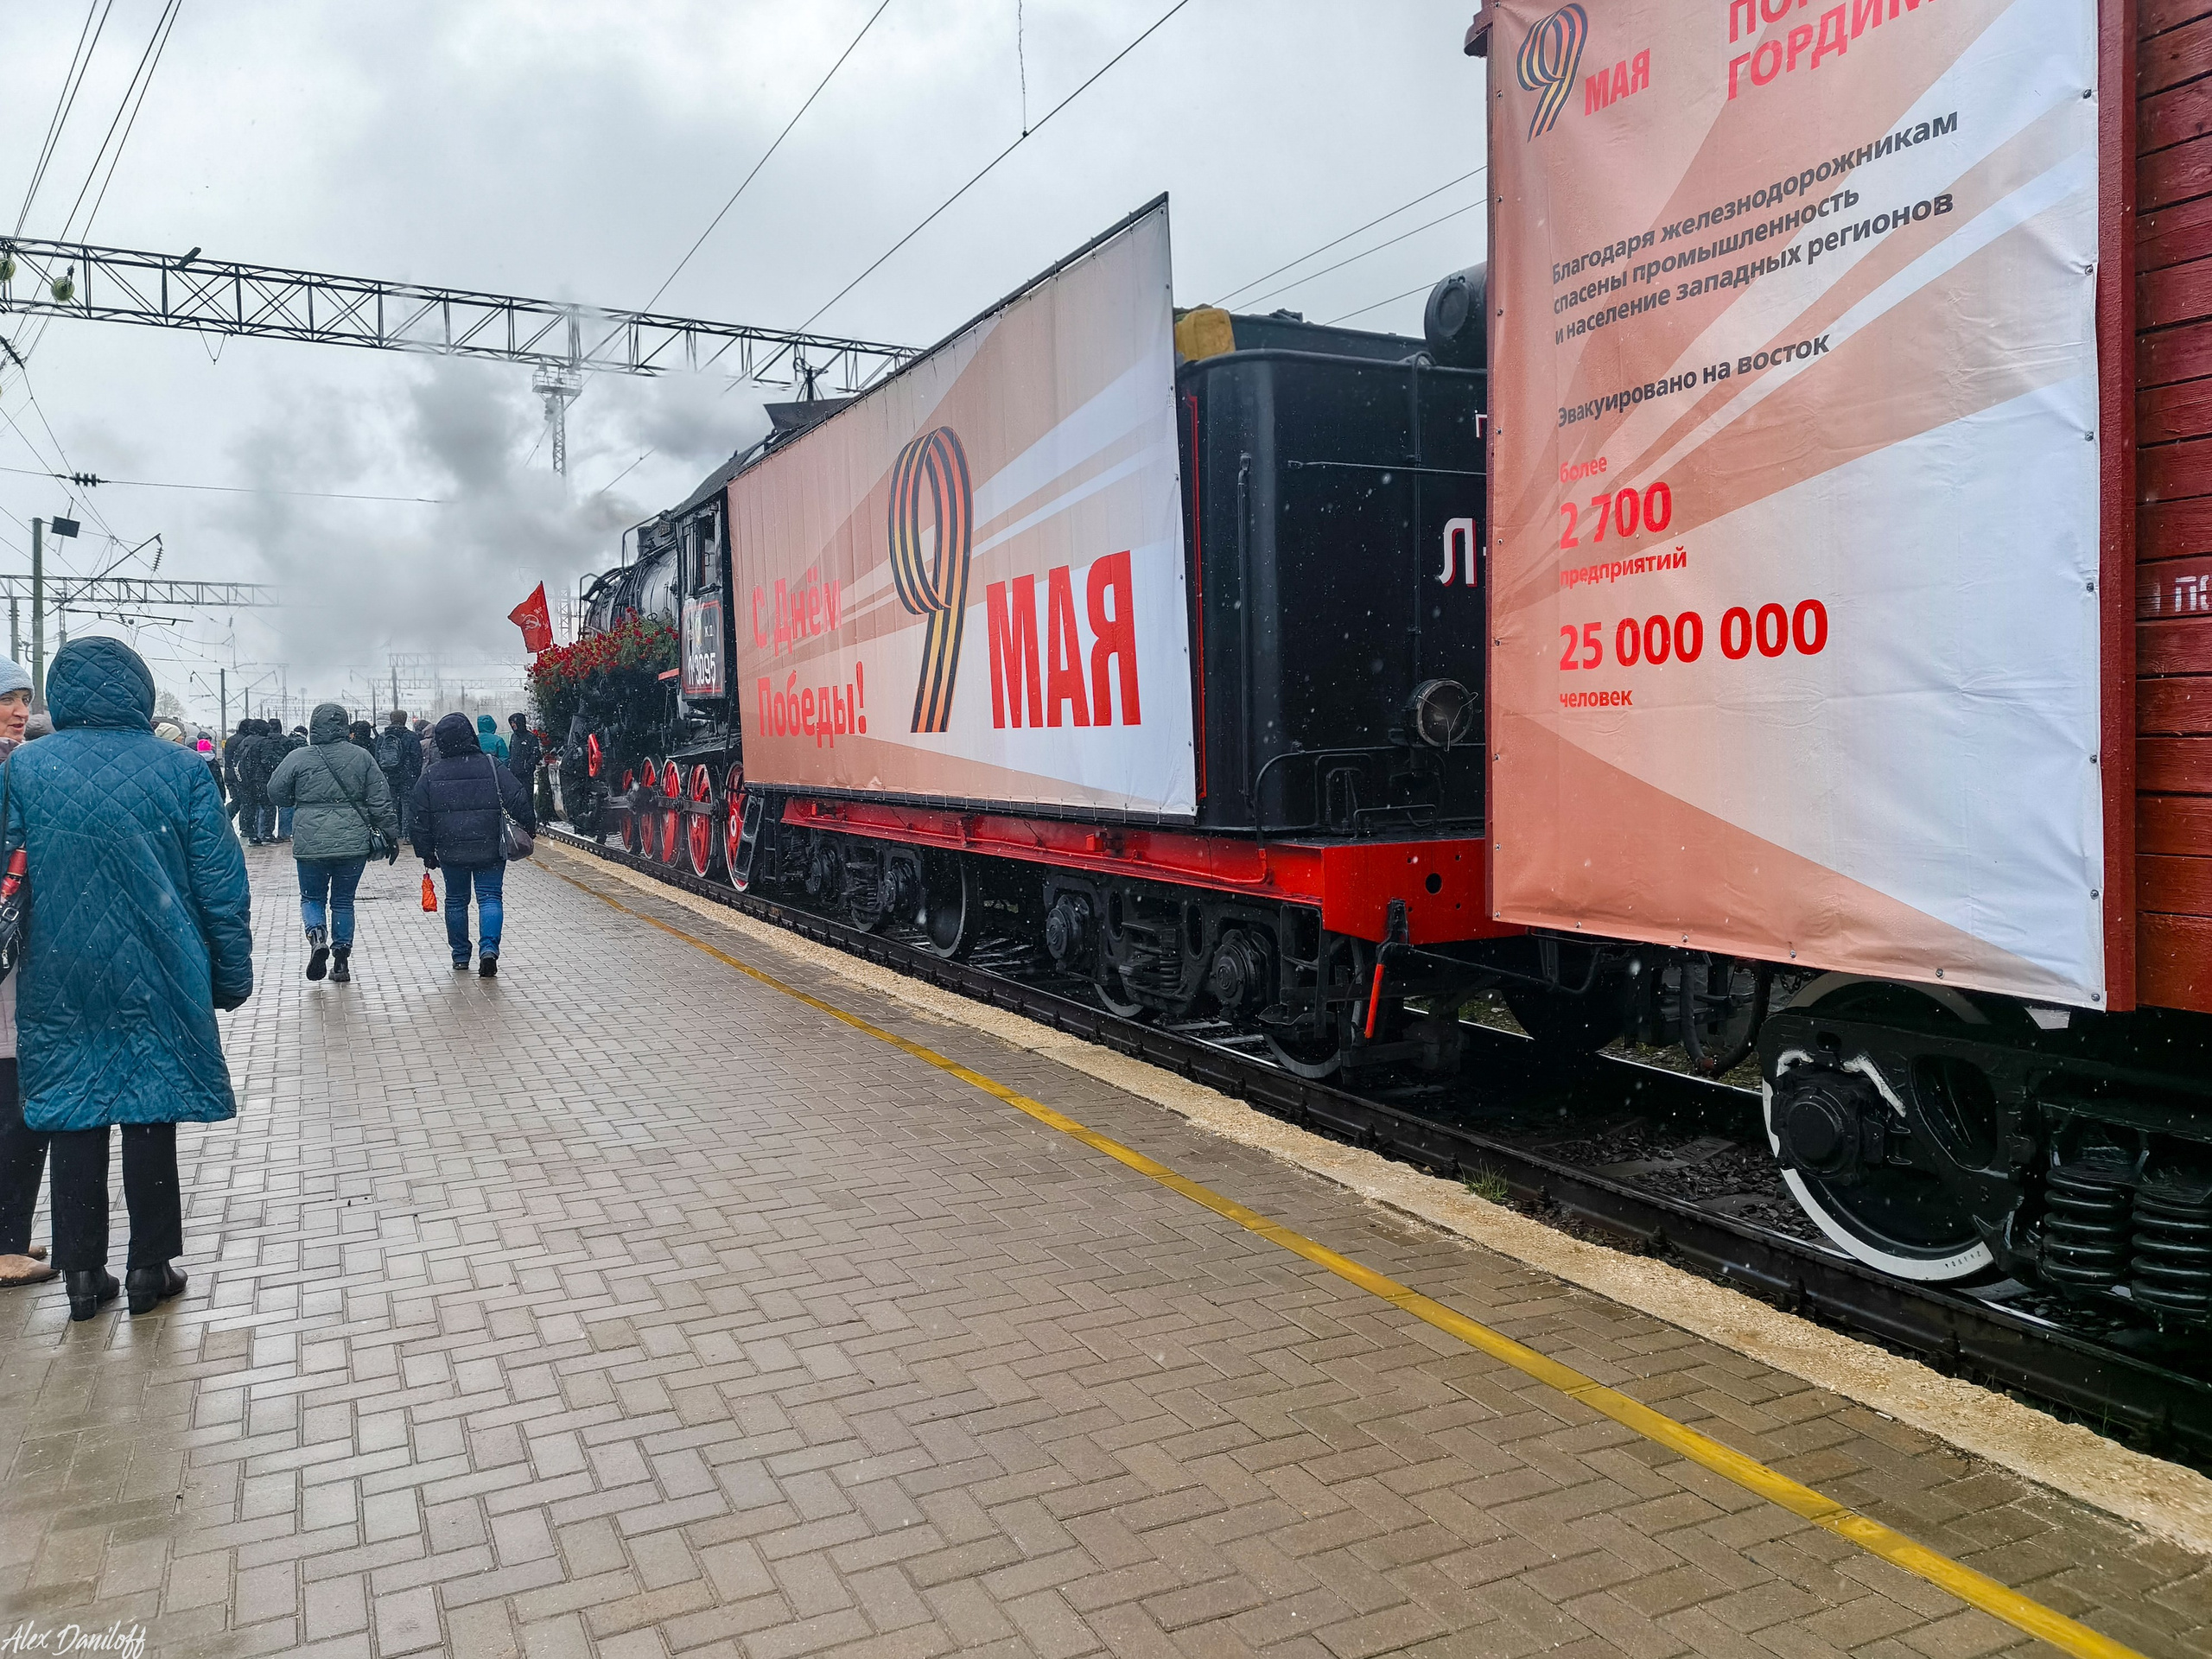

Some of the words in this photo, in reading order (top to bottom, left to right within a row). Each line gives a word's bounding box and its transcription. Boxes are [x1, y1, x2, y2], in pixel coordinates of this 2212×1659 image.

[1585, 48, 1650, 117] МАЯ
[1552, 230, 1656, 285] Благодаря
[1660, 111, 1958, 244] железнодорожникам
[1554, 270, 1628, 315] спасены
[1632, 188, 1860, 284] промышленность
[1554, 329, 1565, 346] и
[1567, 288, 1671, 340] население
[1675, 244, 1802, 302] западных
[1807, 193, 1955, 265] регионов
[1558, 371, 1697, 428] Эвакуировано
[1702, 360, 1732, 385] на
[1737, 334, 1831, 375] восток
[1559, 456, 1608, 484] более
[1591, 481, 1673, 543] 700
[752, 585, 768, 650] С
[773, 565, 843, 658] Днём
[1559, 545, 1688, 589] предприятий
[986, 550, 1141, 729] МАЯ
[1559, 620, 1604, 671] 25
[1615, 610, 1704, 668] 000
[1719, 598, 1829, 661] 000
[756, 660, 867, 749] Победы!
[1559, 689, 1634, 709] человек
